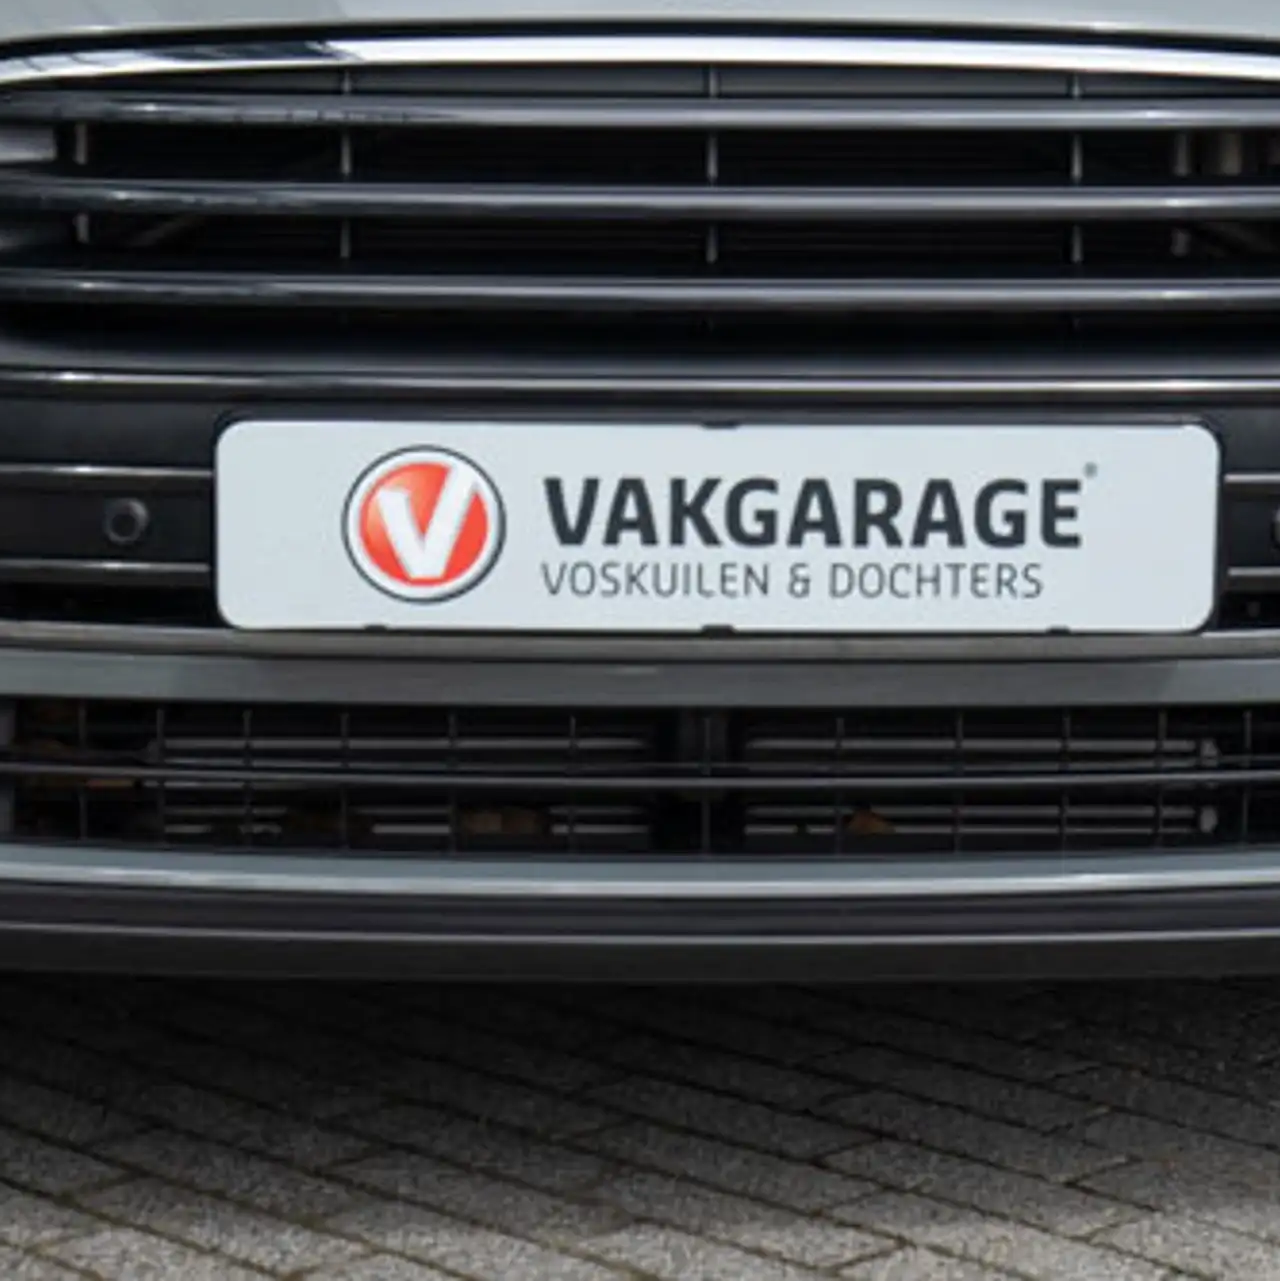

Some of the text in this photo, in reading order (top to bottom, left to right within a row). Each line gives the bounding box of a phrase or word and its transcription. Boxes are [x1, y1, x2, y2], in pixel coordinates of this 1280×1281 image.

[542, 476, 1083, 550] VAKGARAGE
[540, 560, 1042, 599] VOSKUILEN & DOCHTERS
